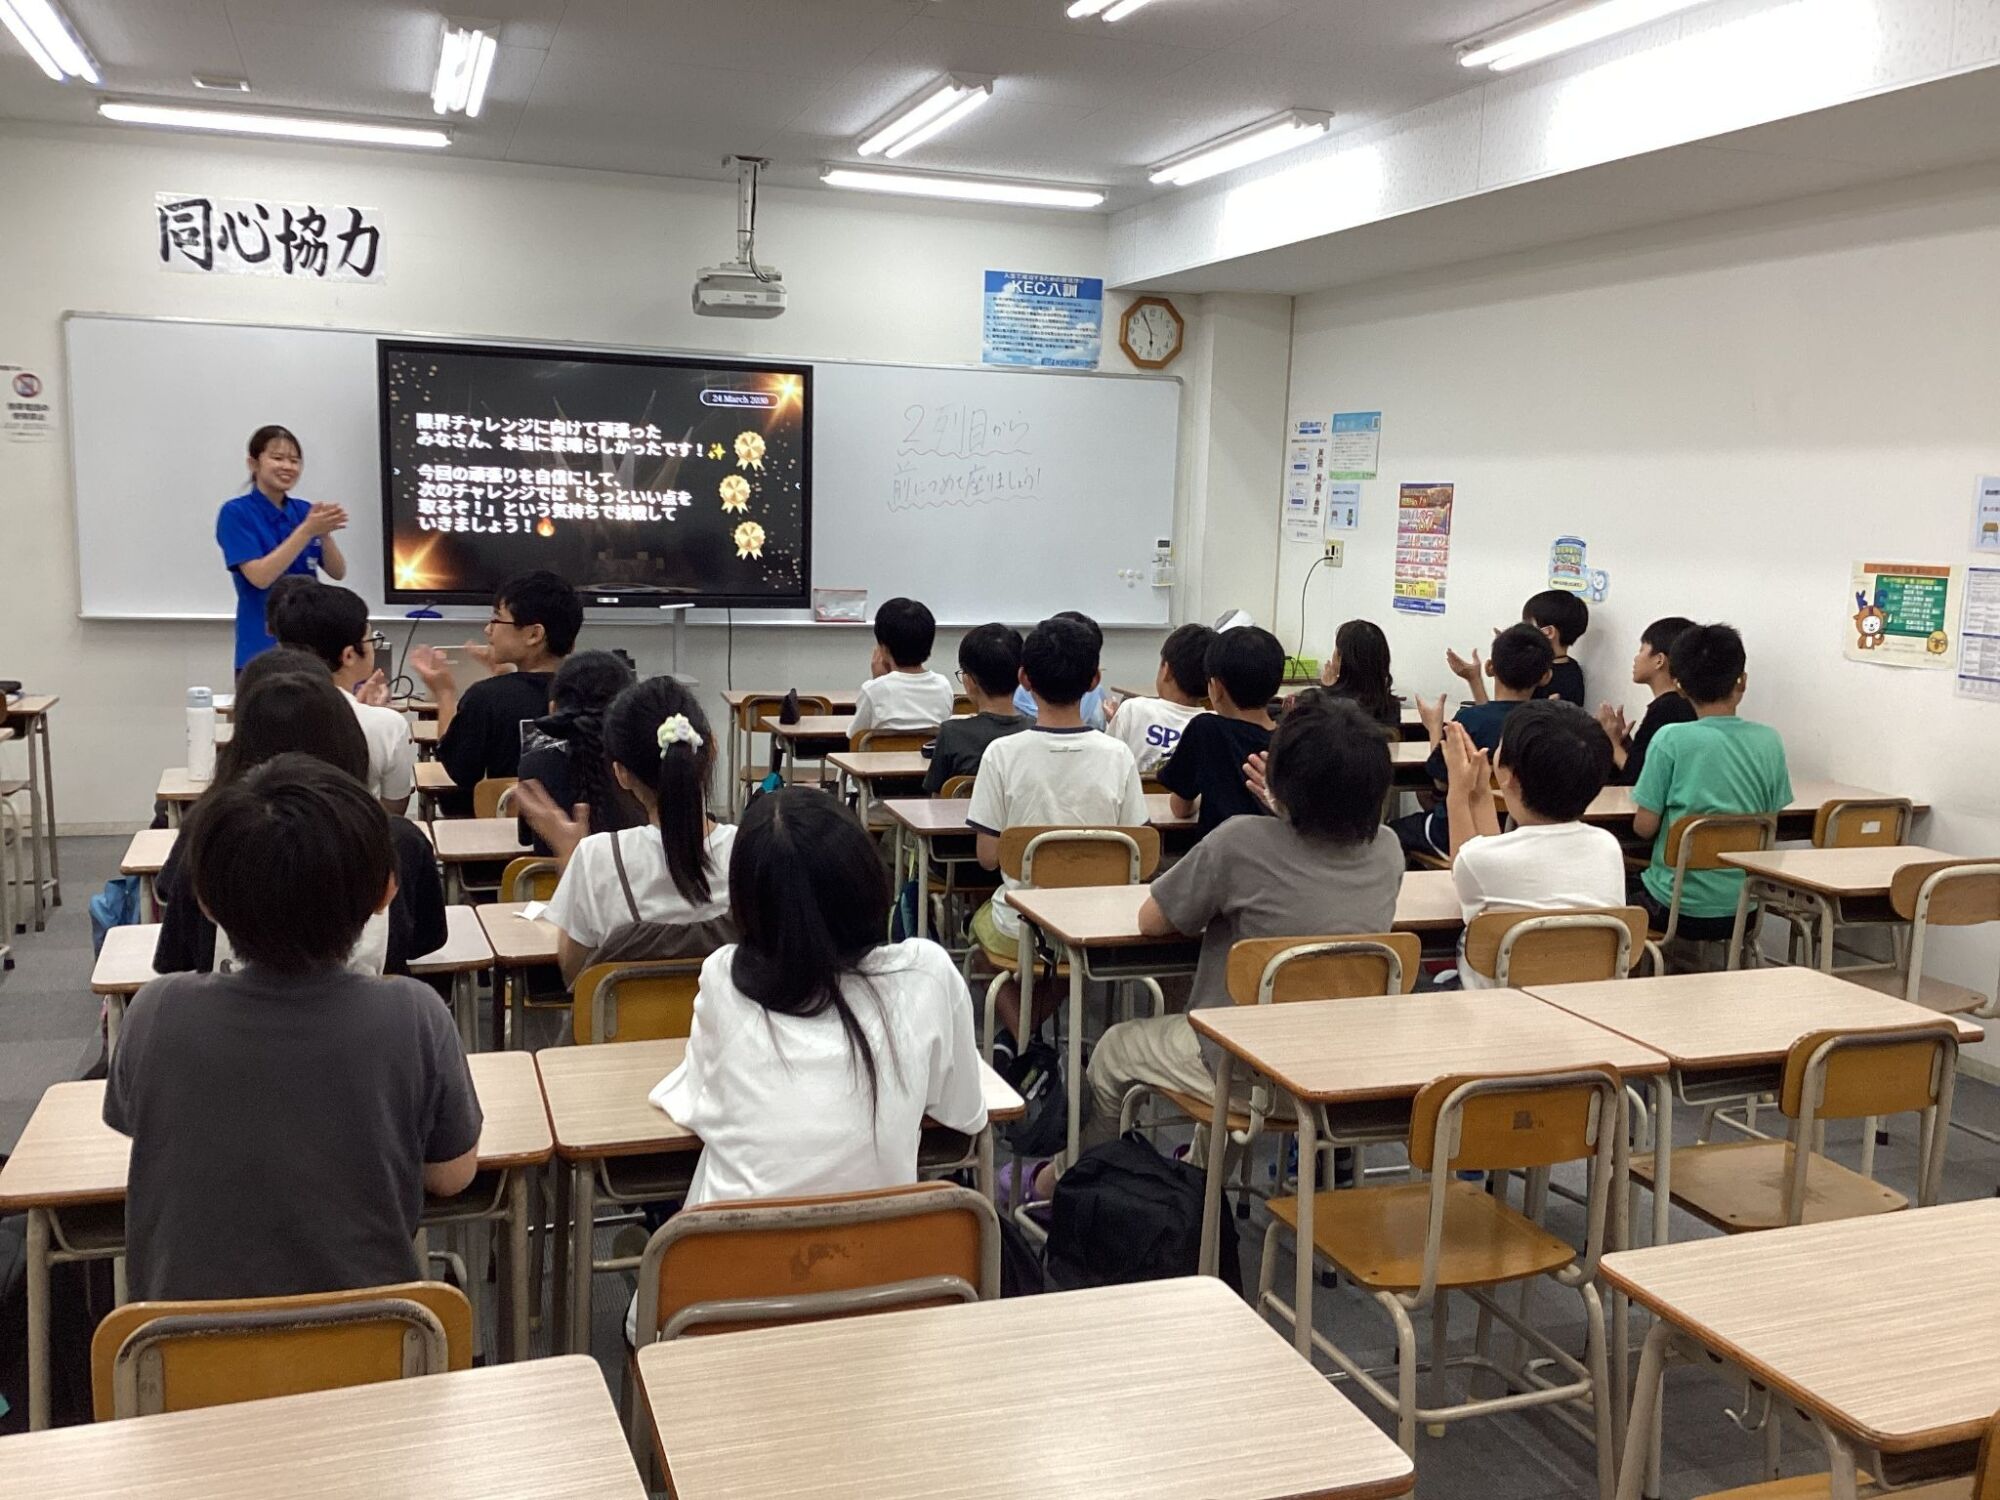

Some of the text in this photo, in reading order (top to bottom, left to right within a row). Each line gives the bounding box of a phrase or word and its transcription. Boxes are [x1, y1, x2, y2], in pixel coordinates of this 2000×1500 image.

[157, 198, 380, 277] 同心協力
[723, 394, 749, 404] March
[416, 413, 662, 439] 限界チャレンジに向けて頑張った
[417, 463, 621, 487] 今回の頑張りを自信にして、
[418, 481, 693, 507] 次のチャレンジでは「もっといい点を
[419, 515, 532, 534] いきましょう！
